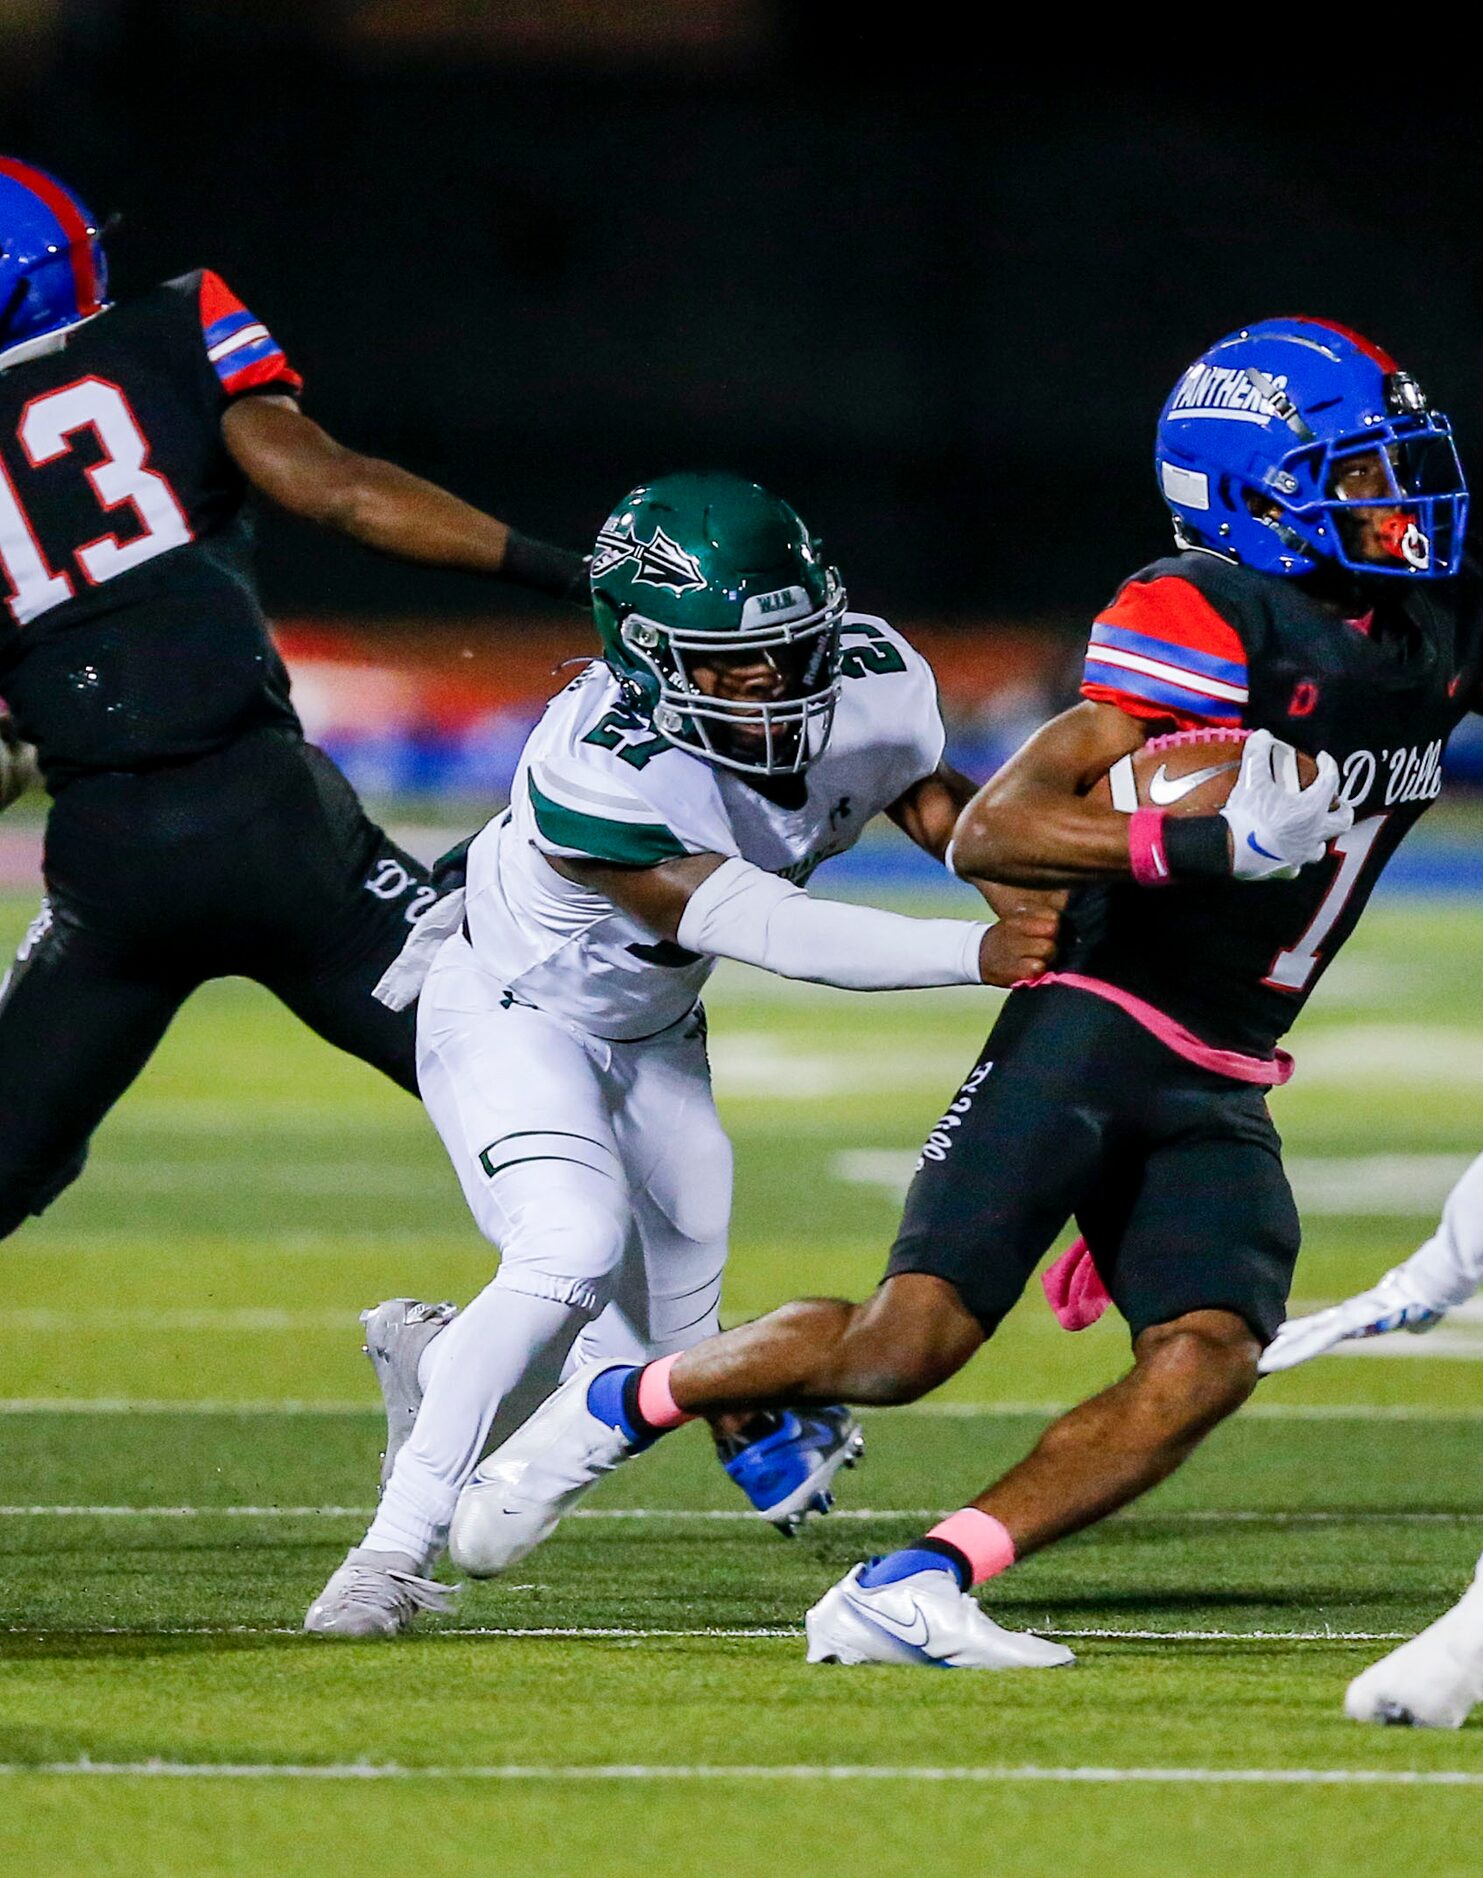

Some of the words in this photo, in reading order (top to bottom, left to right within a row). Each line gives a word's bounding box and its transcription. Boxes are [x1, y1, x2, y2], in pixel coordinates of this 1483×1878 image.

[0, 374, 195, 627] 13
[580, 702, 677, 771] 27
[1288, 682, 1319, 717] D
[1258, 810, 1394, 992] 1
